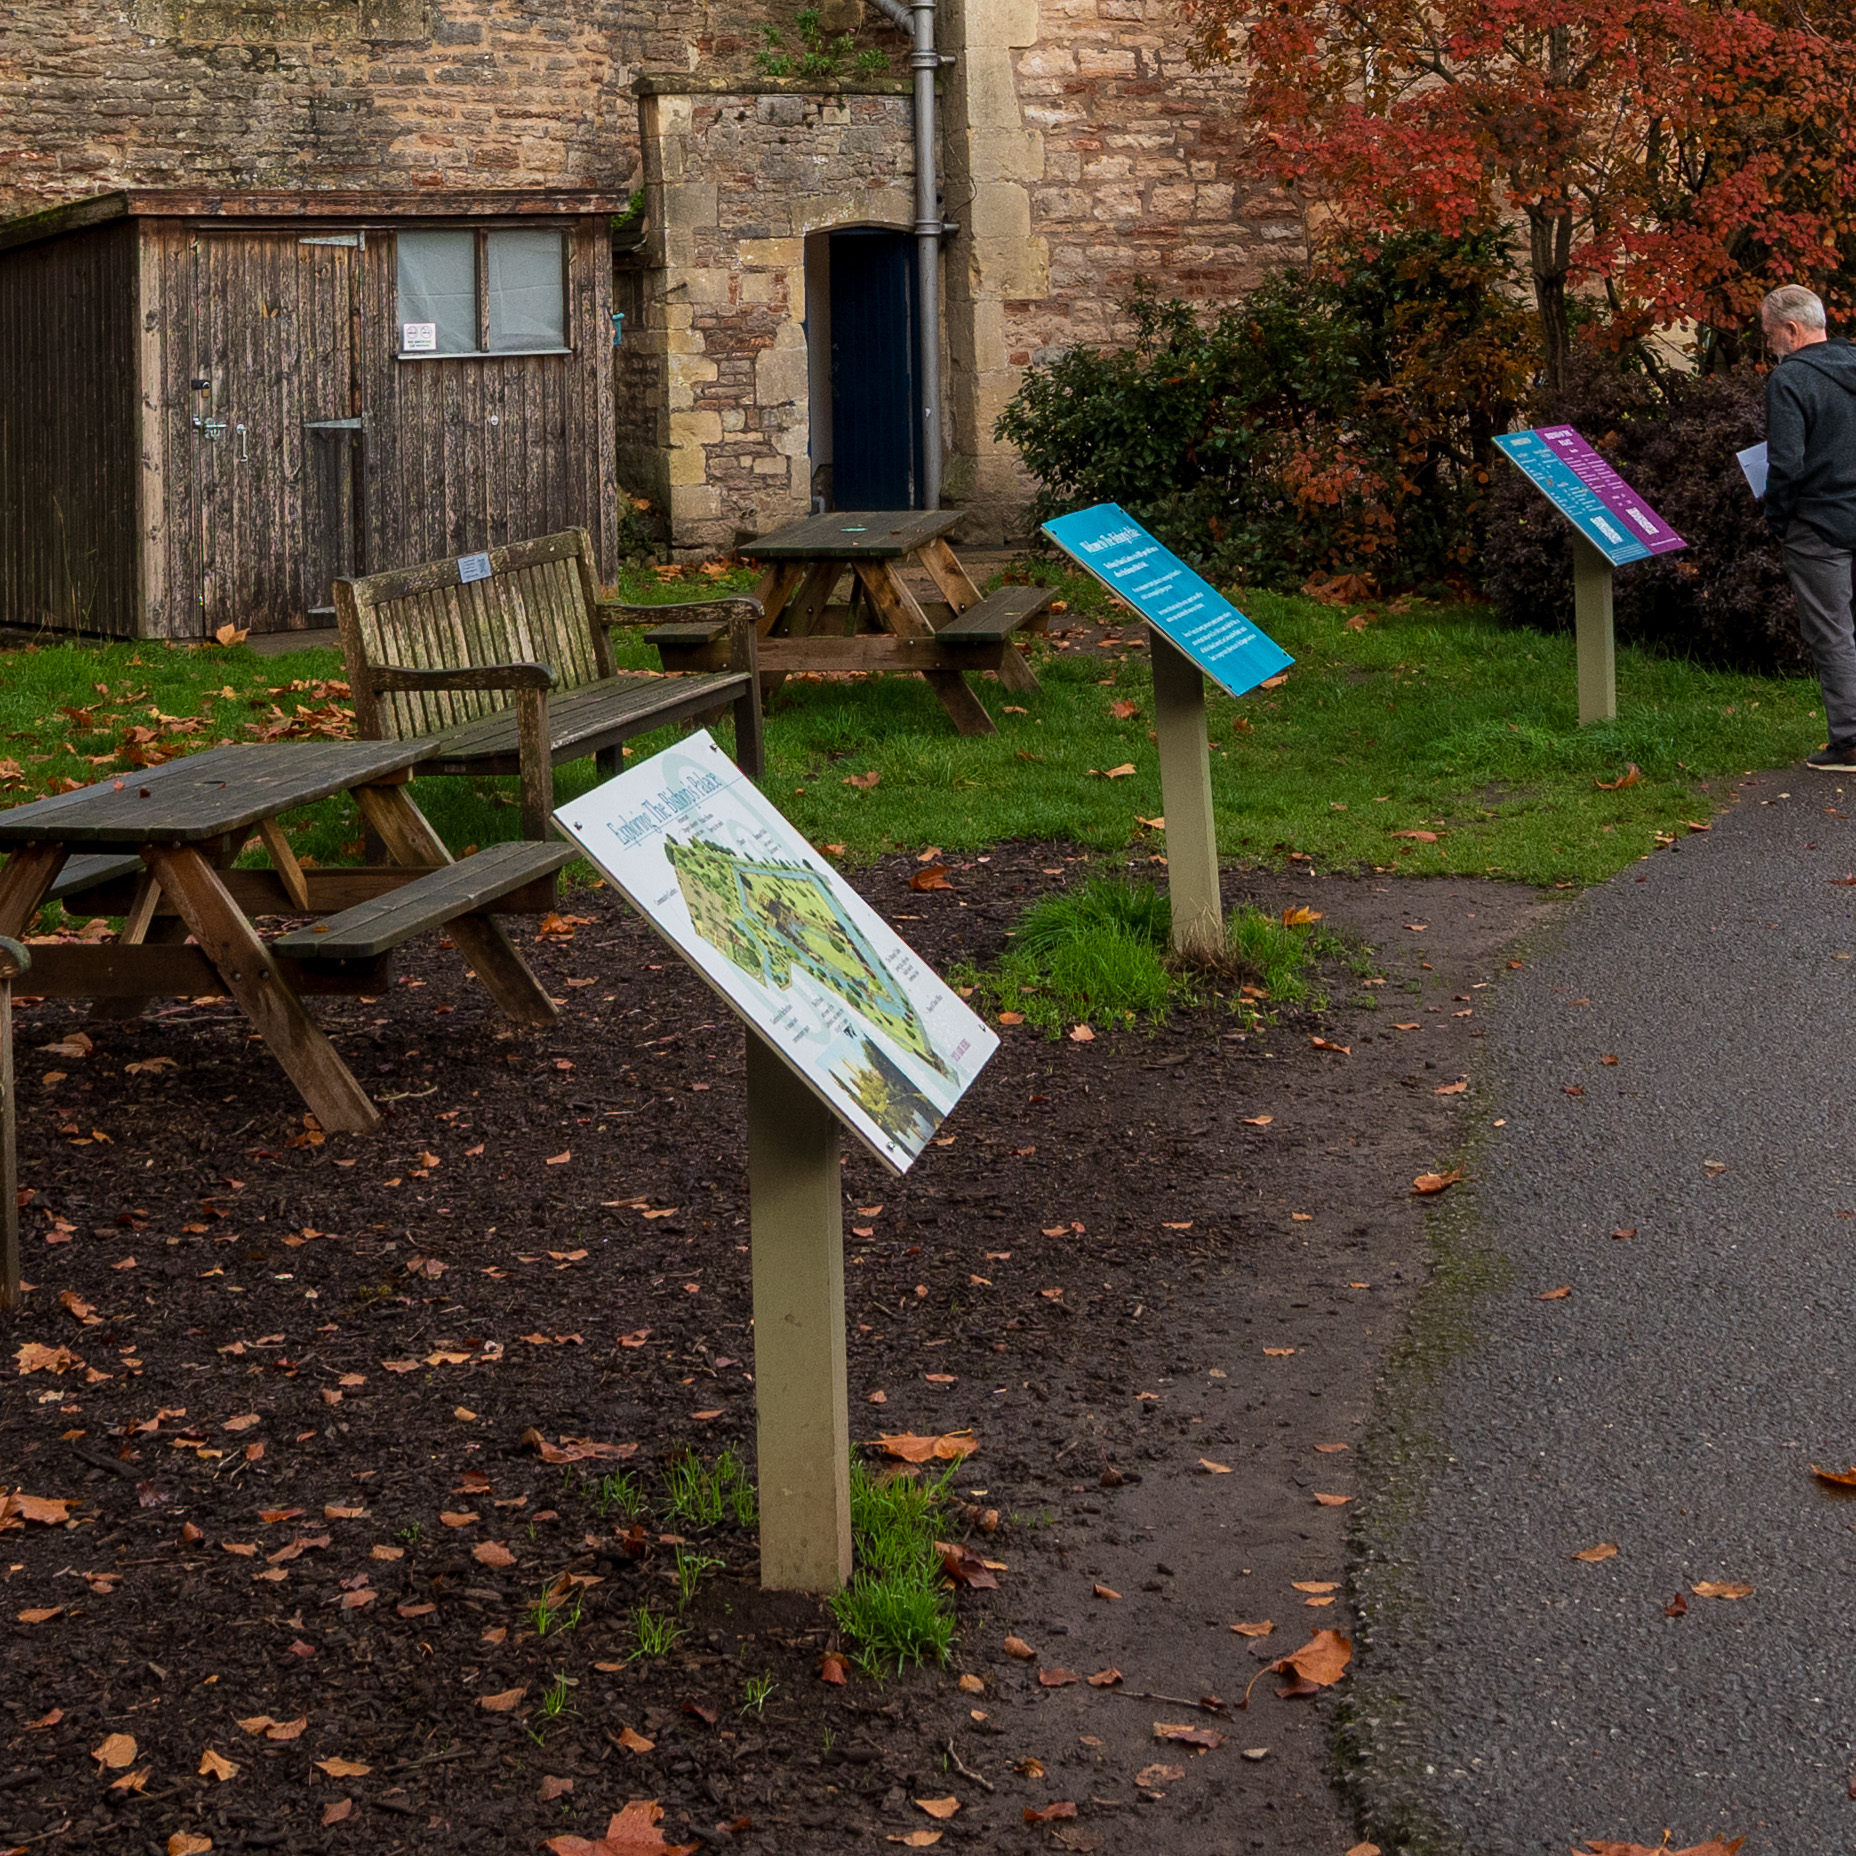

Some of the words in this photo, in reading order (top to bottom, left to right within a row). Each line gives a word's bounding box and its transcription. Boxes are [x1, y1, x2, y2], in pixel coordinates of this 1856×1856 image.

[656, 781, 702, 814] Bishop's
[685, 771, 723, 797] Palace
[641, 799, 672, 823] The
[606, 811, 662, 847] Exploring
